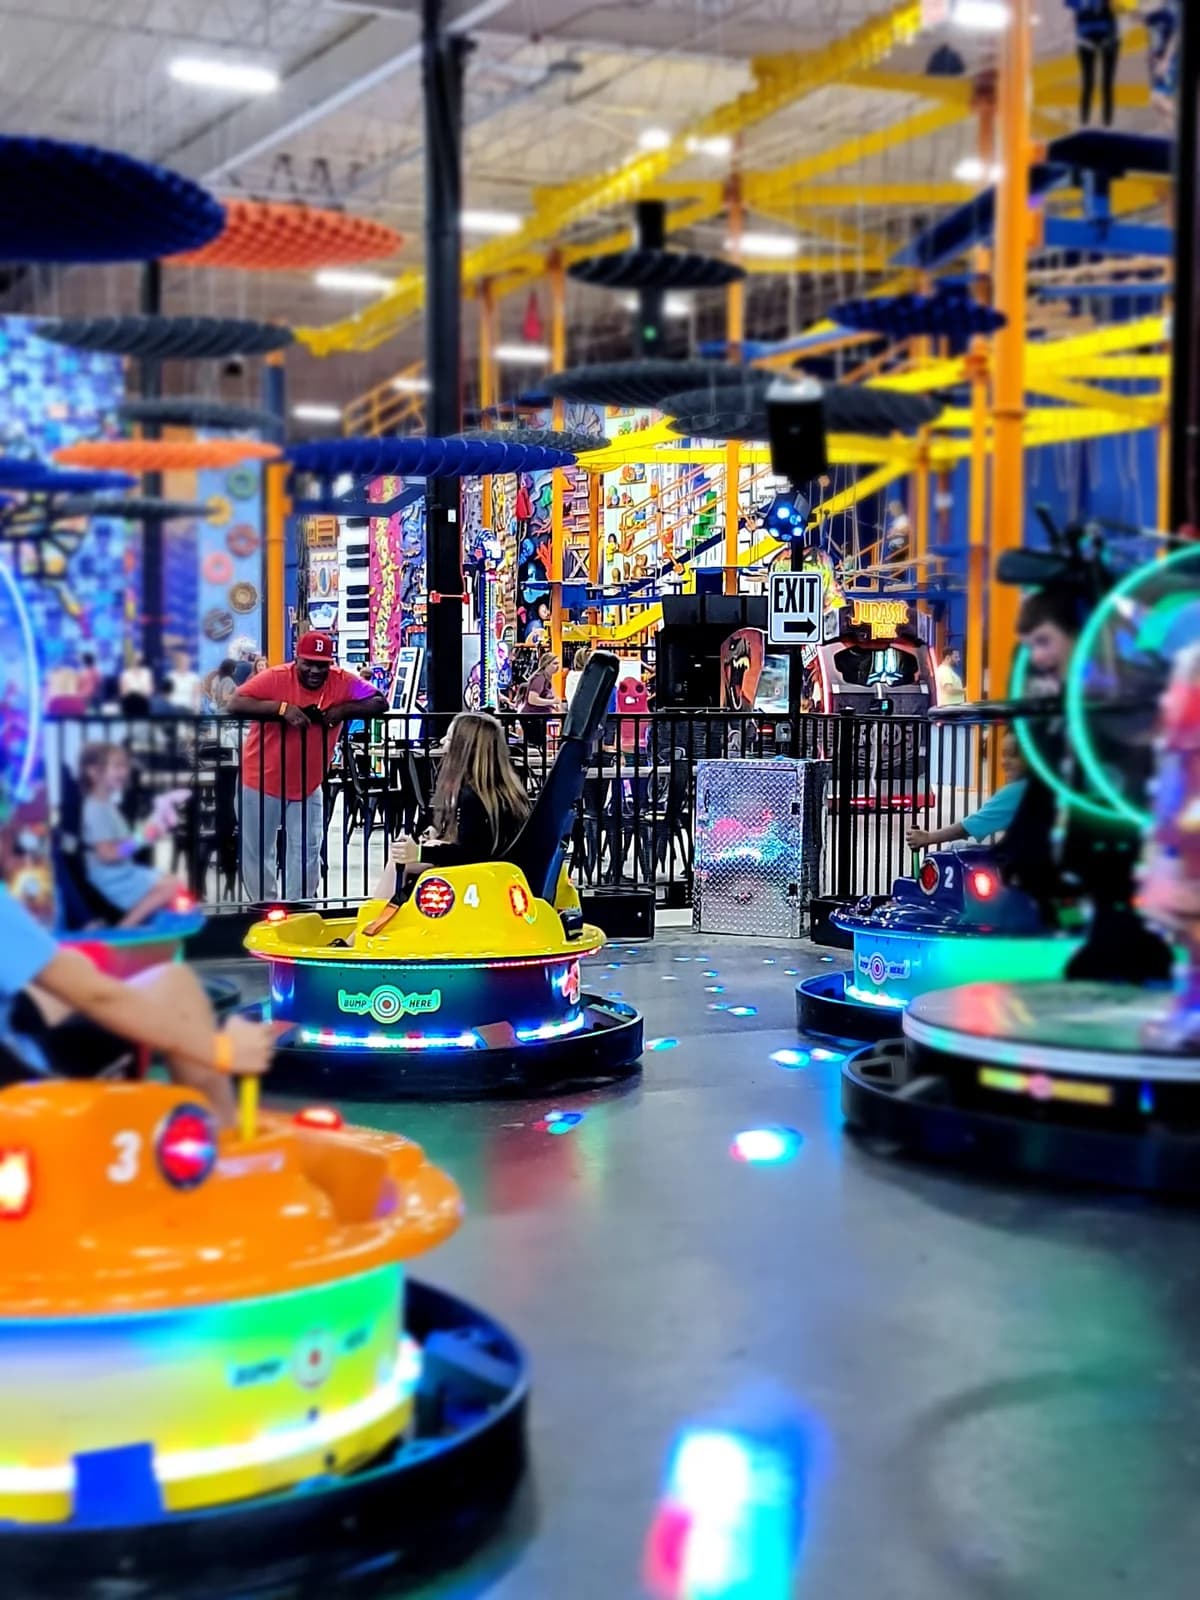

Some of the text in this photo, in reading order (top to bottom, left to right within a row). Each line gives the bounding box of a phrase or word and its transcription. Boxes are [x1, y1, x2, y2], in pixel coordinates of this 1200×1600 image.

[774, 577, 818, 613] EXIT
[850, 599, 909, 625] JURASSIC
[315, 639, 324, 652] B
[944, 865, 954, 889] 2
[463, 882, 480, 908] 4
[343, 999, 432, 1009] BUMP HERE
[106, 1130, 142, 1183] 3
